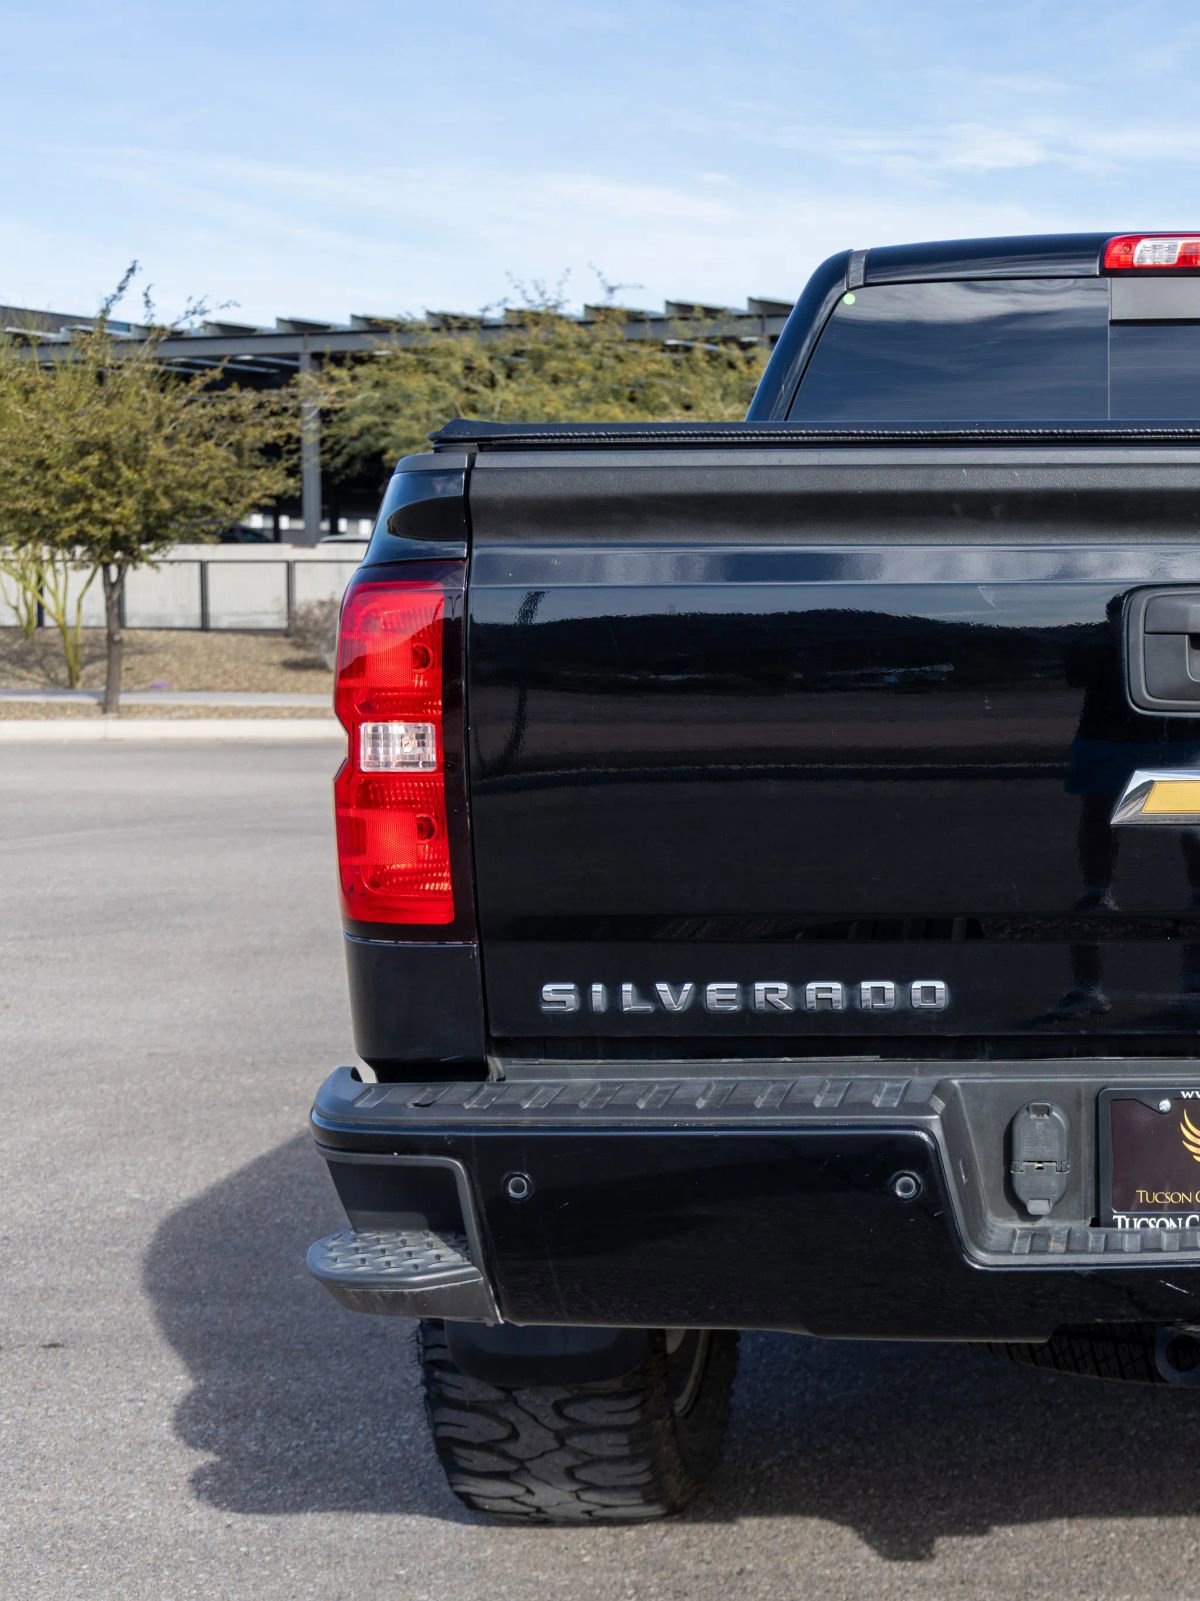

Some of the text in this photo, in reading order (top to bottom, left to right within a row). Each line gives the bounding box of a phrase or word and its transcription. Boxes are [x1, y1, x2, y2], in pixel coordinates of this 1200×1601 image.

[542, 981, 949, 1013] SILVERADO
[1135, 1190, 1192, 1203] TUCSON
[1112, 1215, 1182, 1229] TUCSON
